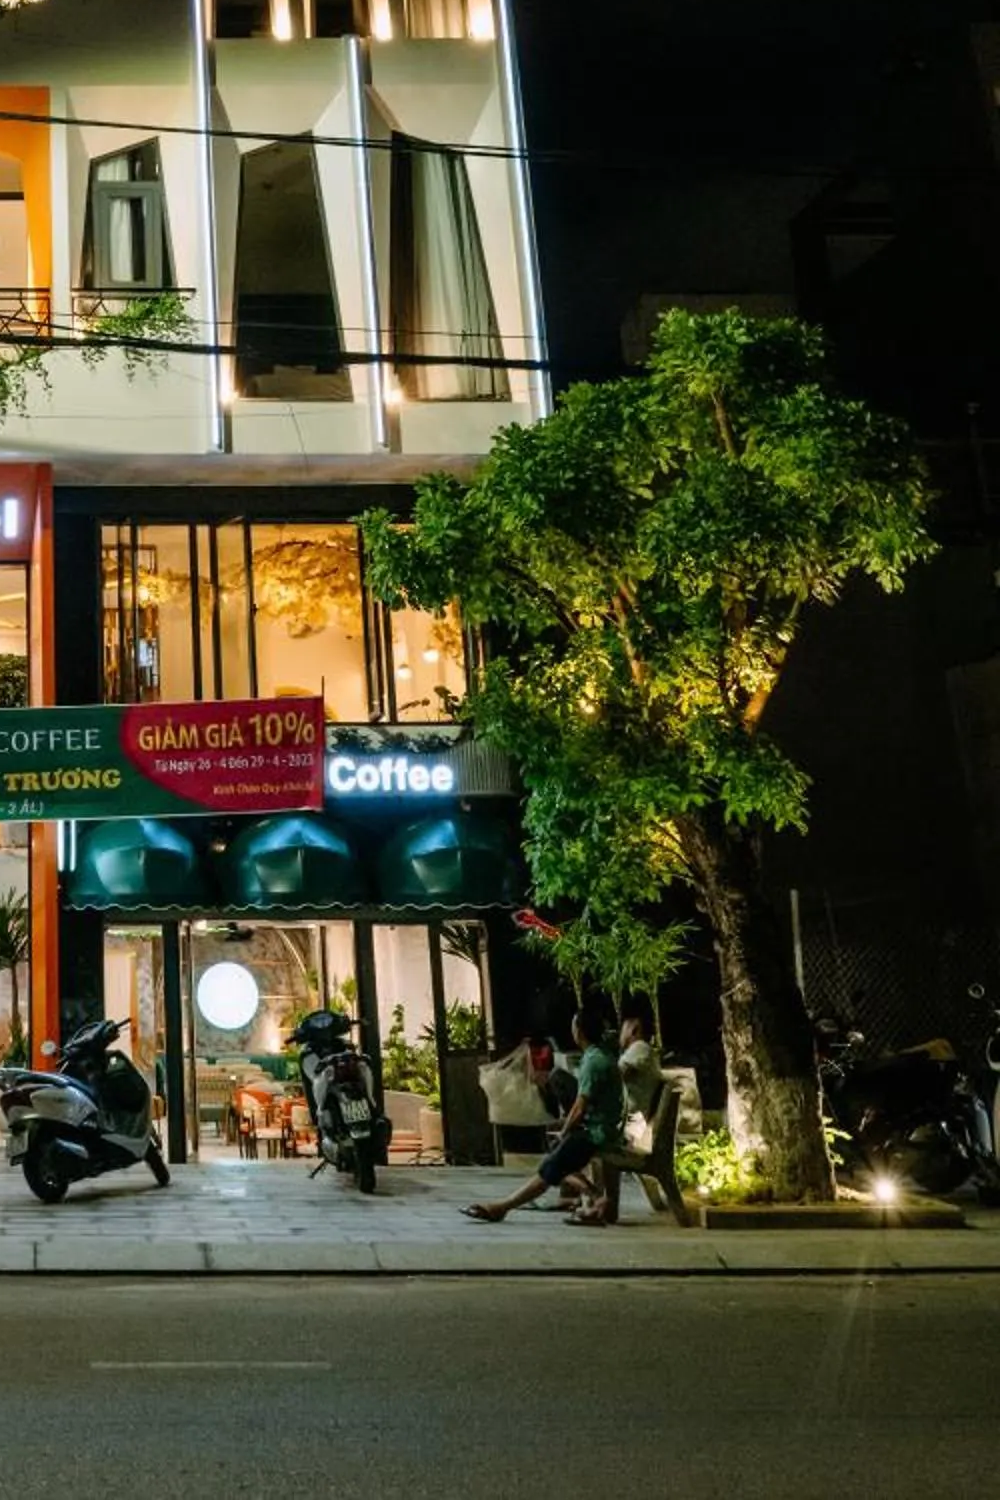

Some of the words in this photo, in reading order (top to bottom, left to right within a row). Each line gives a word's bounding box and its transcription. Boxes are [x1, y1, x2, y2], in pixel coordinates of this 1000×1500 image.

[139, 717, 199, 751] GIẢM
[249, 711, 316, 746] 10%
[3, 766, 123, 792] TRƯƠNG
[328, 756, 454, 792] Coffee
